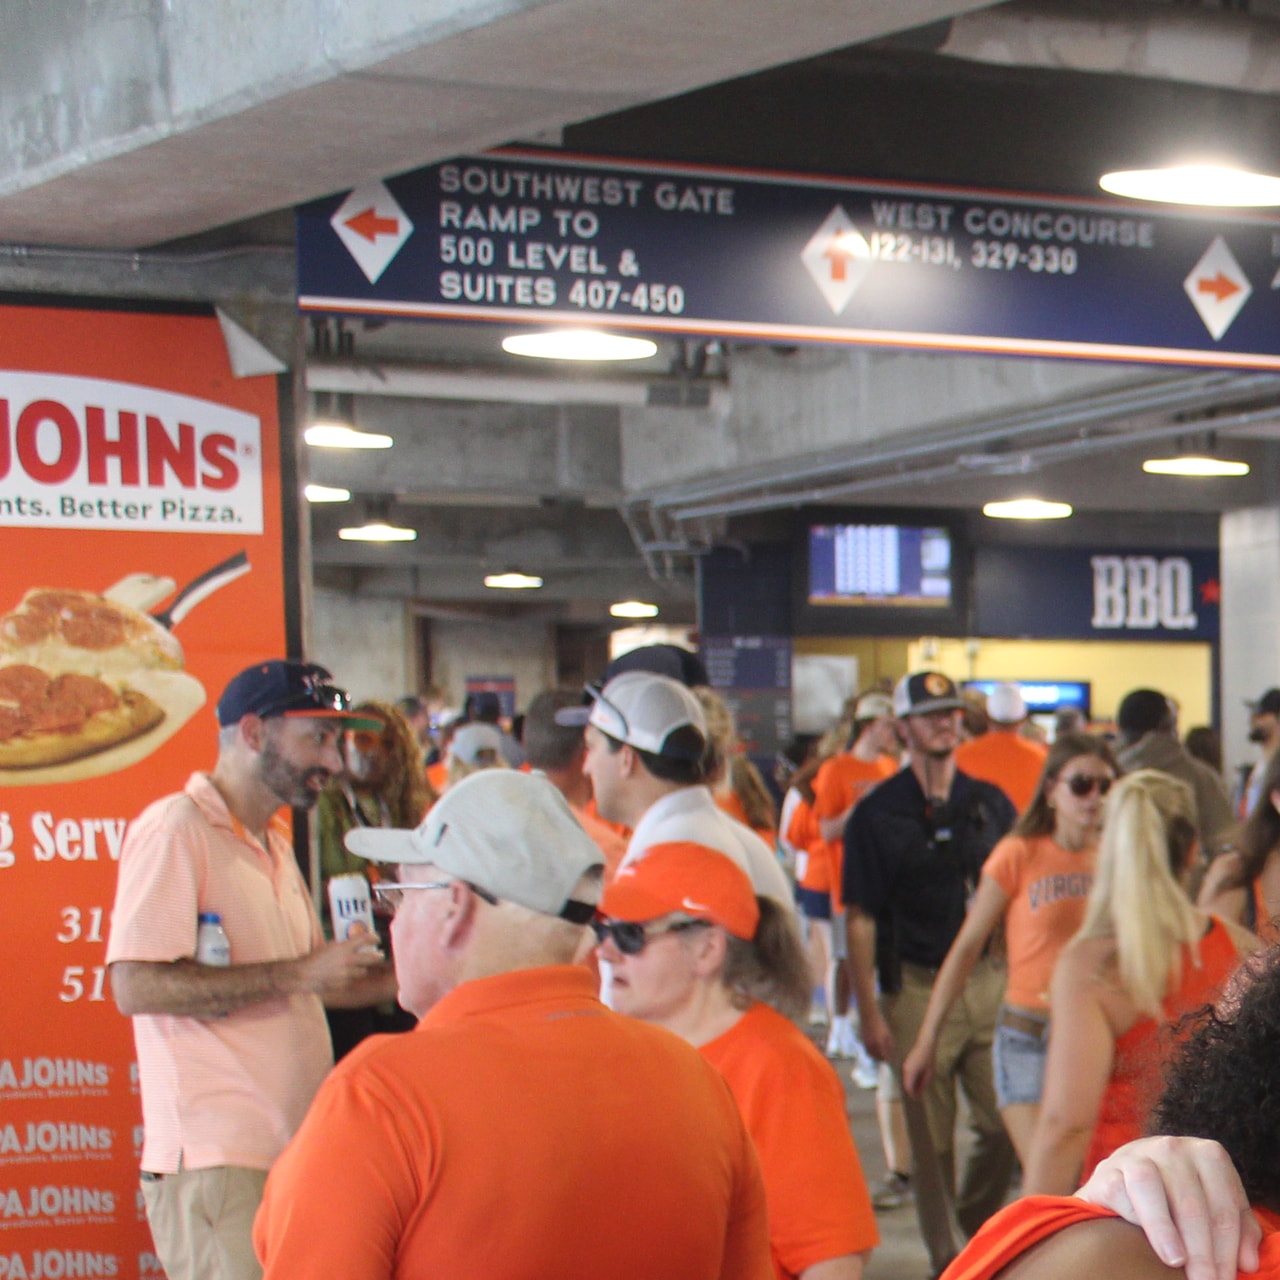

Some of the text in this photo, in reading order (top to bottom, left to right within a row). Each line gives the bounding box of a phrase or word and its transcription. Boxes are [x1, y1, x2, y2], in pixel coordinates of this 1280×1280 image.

[438, 164, 736, 214] SOUTHWEST GATE
[439, 201, 599, 237] RAMP TO
[871, 200, 1155, 248] WEST CONCOURSE
[439, 235, 640, 277] 500 LEVEL &
[870, 231, 1078, 275] 122-131, 329-330
[439, 270, 685, 314] SUITES 407-450
[59, 495, 154, 520] Better
[160, 499, 243, 523] Pizza.
[1089, 555, 1198, 631] BBQ
[0, 1120, 113, 1154] AJOHNS
